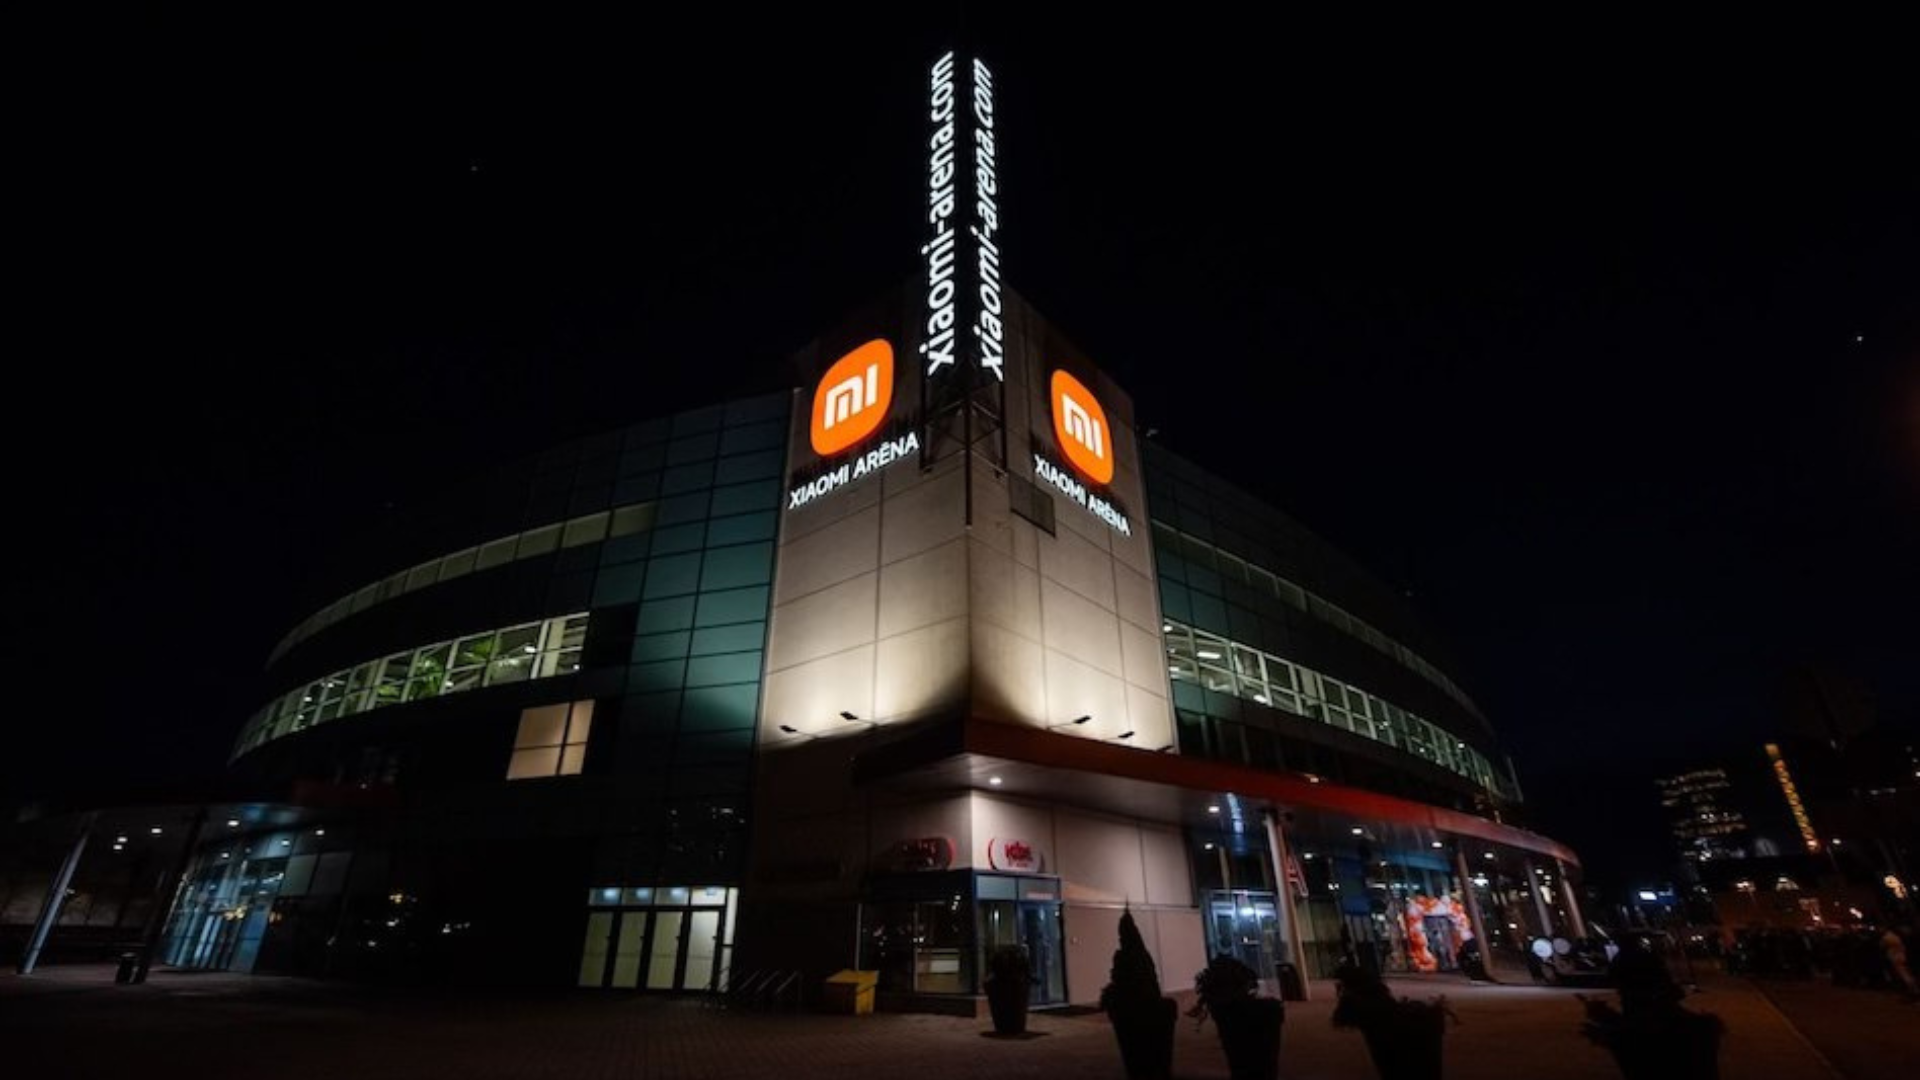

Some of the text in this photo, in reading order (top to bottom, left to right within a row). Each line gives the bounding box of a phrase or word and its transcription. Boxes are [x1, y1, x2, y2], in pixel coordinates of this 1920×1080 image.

[919, 51, 955, 376] xiaomi-arena.com
[970, 58, 1004, 382] xiaomi-arena.com
[788, 464, 850, 510] XIAOMI
[1034, 454, 1087, 506] XIAOMI
